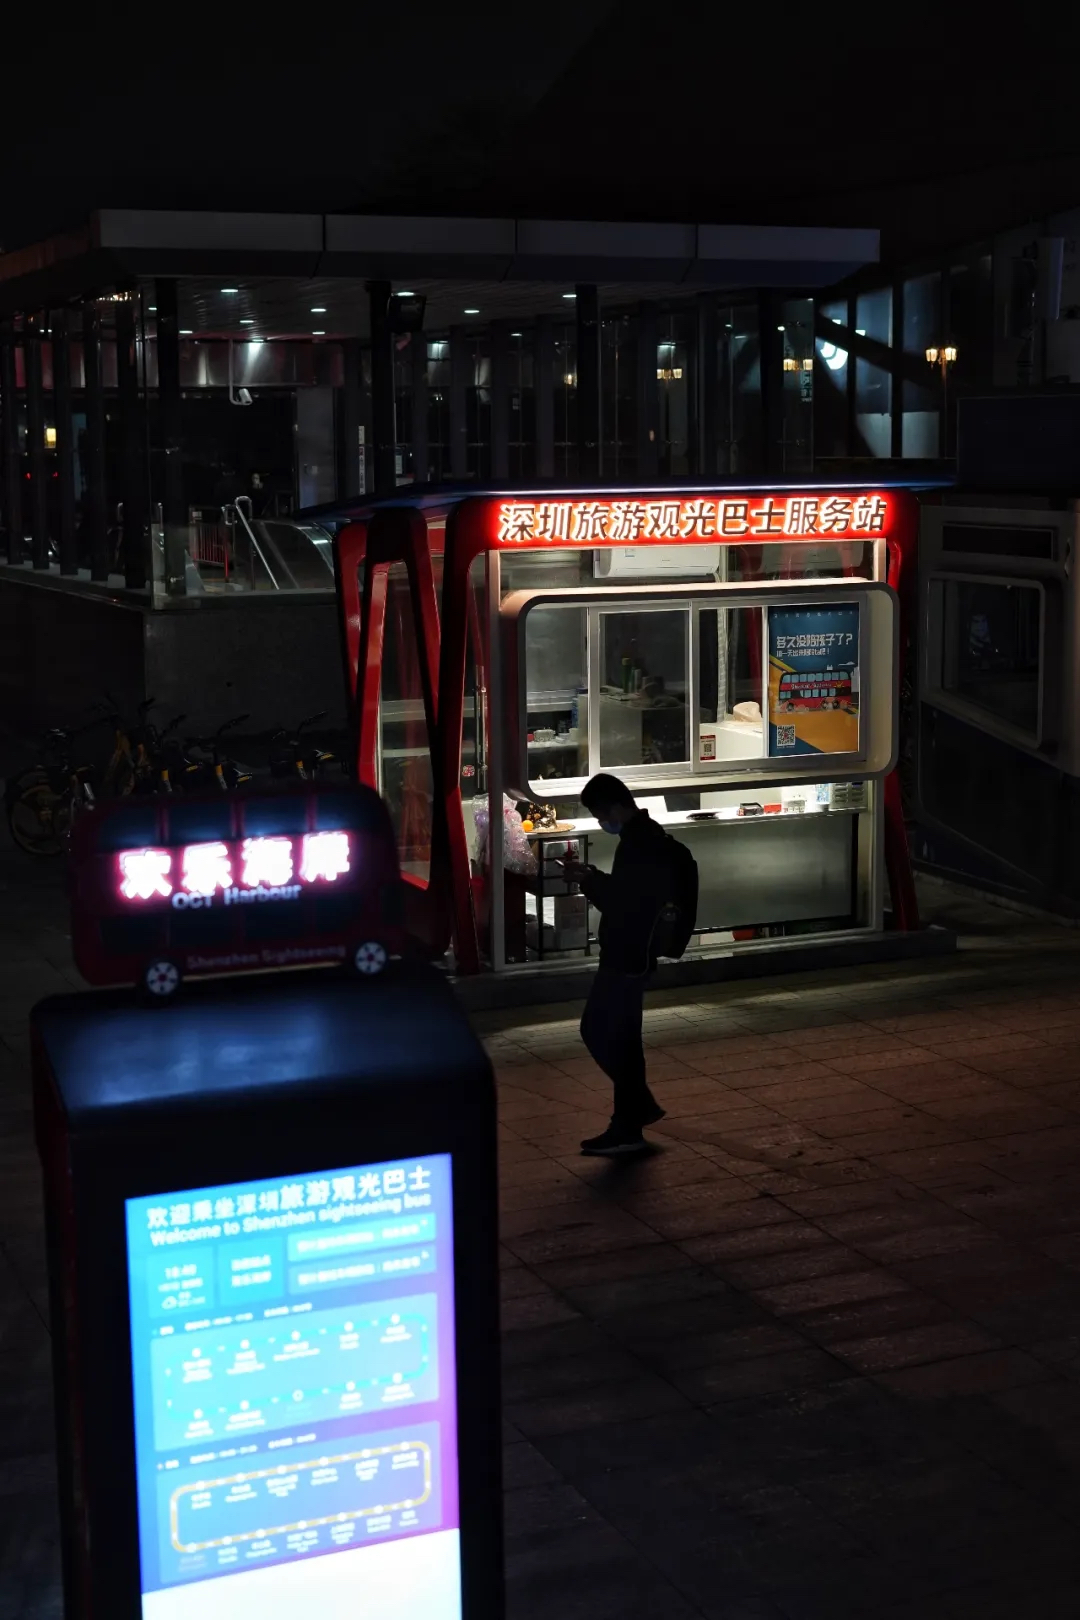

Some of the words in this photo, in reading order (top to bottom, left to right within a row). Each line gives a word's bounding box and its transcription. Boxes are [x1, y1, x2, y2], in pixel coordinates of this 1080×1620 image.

[497, 495, 887, 541] 深圳旅游观光巴士服务站
[172, 890, 214, 909] OCT
[224, 884, 302, 905] Harbour
[147, 1165, 430, 1227] 欢迎乘坐深圳旅游观光巴士
[150, 1224, 221, 1247] Welcome
[223, 1221, 240, 1236] to
[243, 1210, 315, 1232] Shenzhen
[404, 1192, 431, 1209] bus
